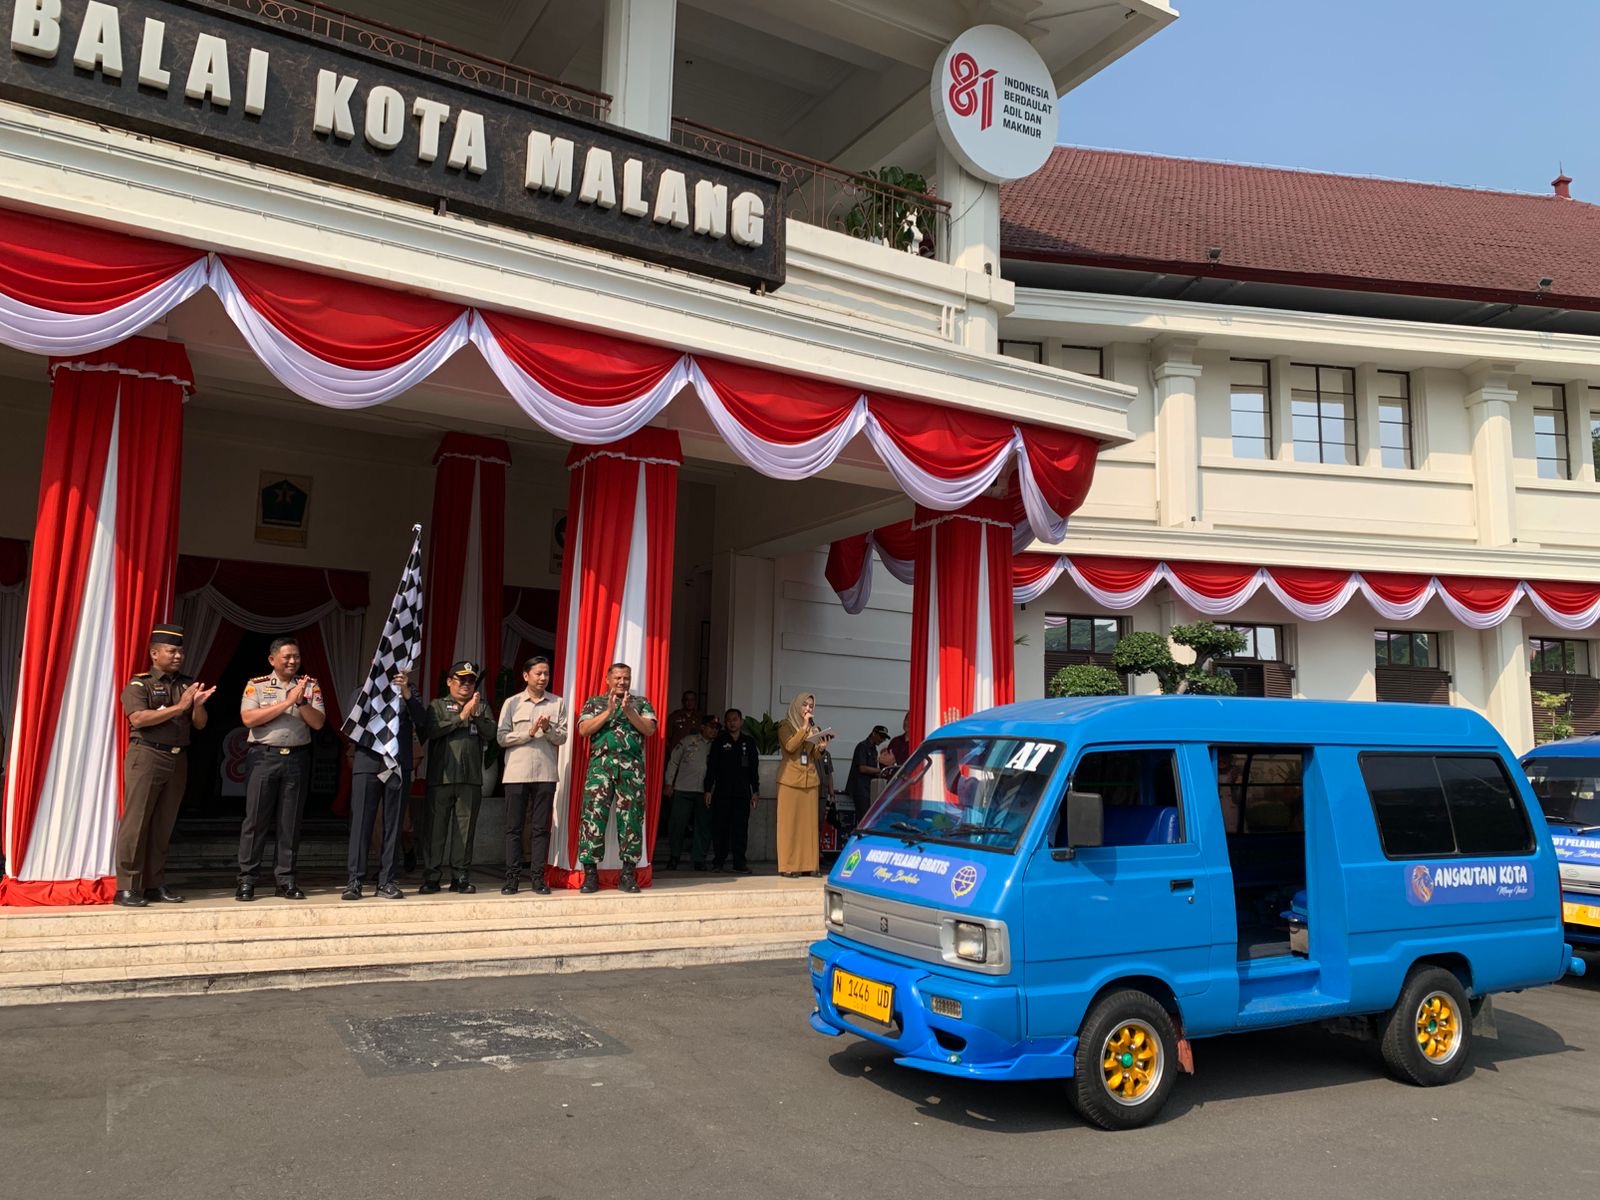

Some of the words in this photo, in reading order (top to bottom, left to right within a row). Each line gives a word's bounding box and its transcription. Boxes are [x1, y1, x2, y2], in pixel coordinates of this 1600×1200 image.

[949, 52, 999, 131] 81
[1004, 76, 1049, 100] INDONESIA
[1003, 91, 1052, 115] BERDAULAT
[1003, 105, 1022, 119] ADIL
[1024, 111, 1042, 125] DAN
[11, 0, 270, 116] BALAI
[313, 68, 488, 175] KOTA
[524, 130, 765, 248] MALANG
[1003, 118, 1042, 139] MAKMUR
[1004, 742, 1056, 772] AT
[890, 852, 922, 870] PELAJAR
[918, 857, 950, 875] GRATIS
[1434, 866, 1496, 888] ANGKUTAN
[1499, 865, 1527, 884] KOTA
[836, 975, 842, 993] N
[848, 979, 870, 1002] 1446
[877, 986, 890, 1009] UD
